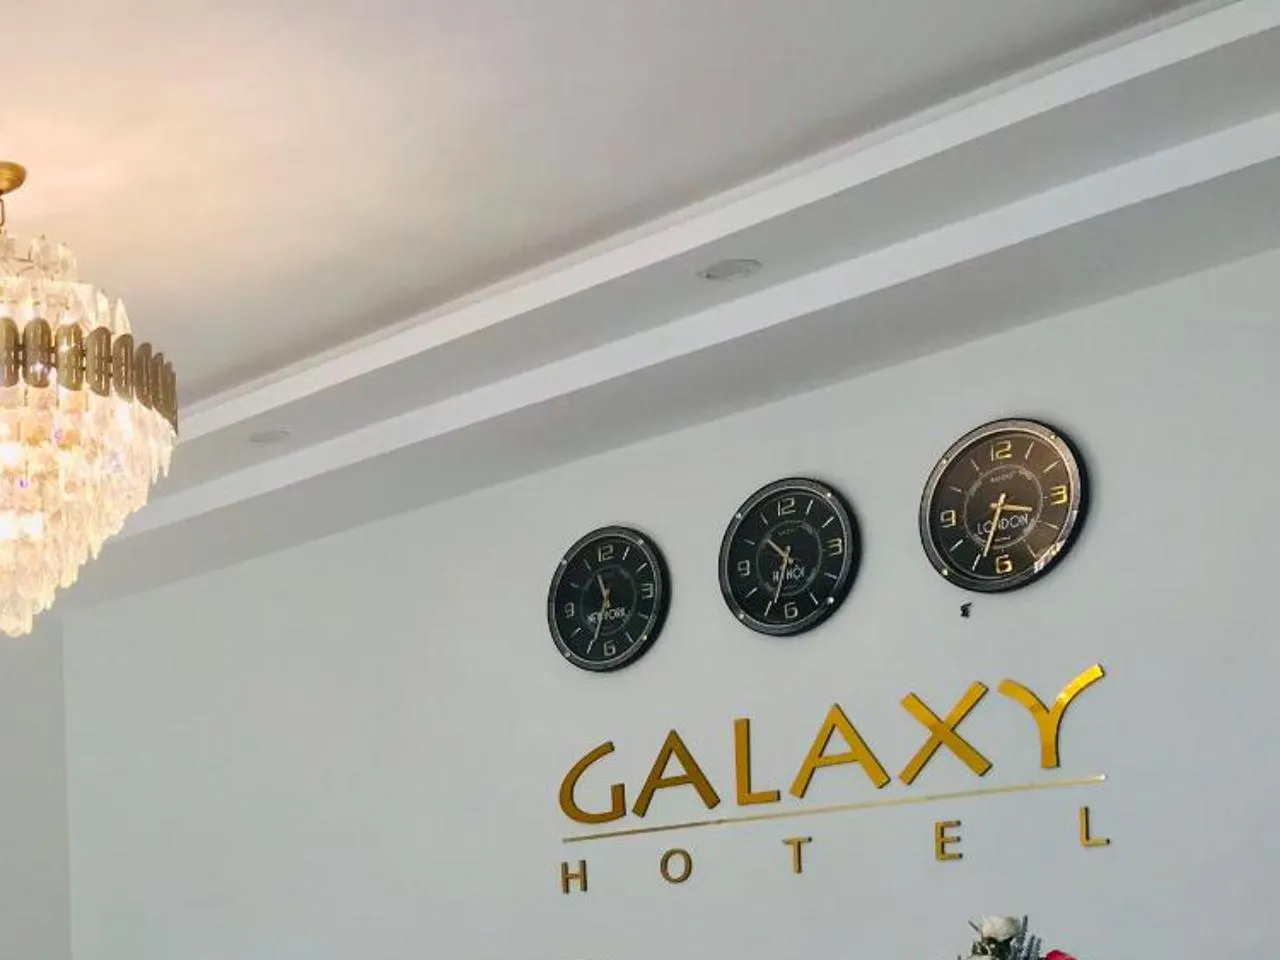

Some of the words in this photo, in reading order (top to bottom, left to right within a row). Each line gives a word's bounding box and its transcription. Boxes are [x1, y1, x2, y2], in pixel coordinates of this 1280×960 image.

[990, 440, 1013, 462] 12
[1049, 485, 1068, 506] 3
[777, 498, 796, 517] 12
[939, 510, 957, 528] 9
[598, 544, 615, 562] 12
[826, 538, 842, 557] 3
[737, 560, 751, 577] 9
[995, 554, 1013, 574] 6
[639, 583, 654, 600] 3
[563, 602, 575, 619] 9
[784, 602, 799, 619] 6
[603, 640, 616, 656] 6
[558, 663, 1106, 825] GALAXY
